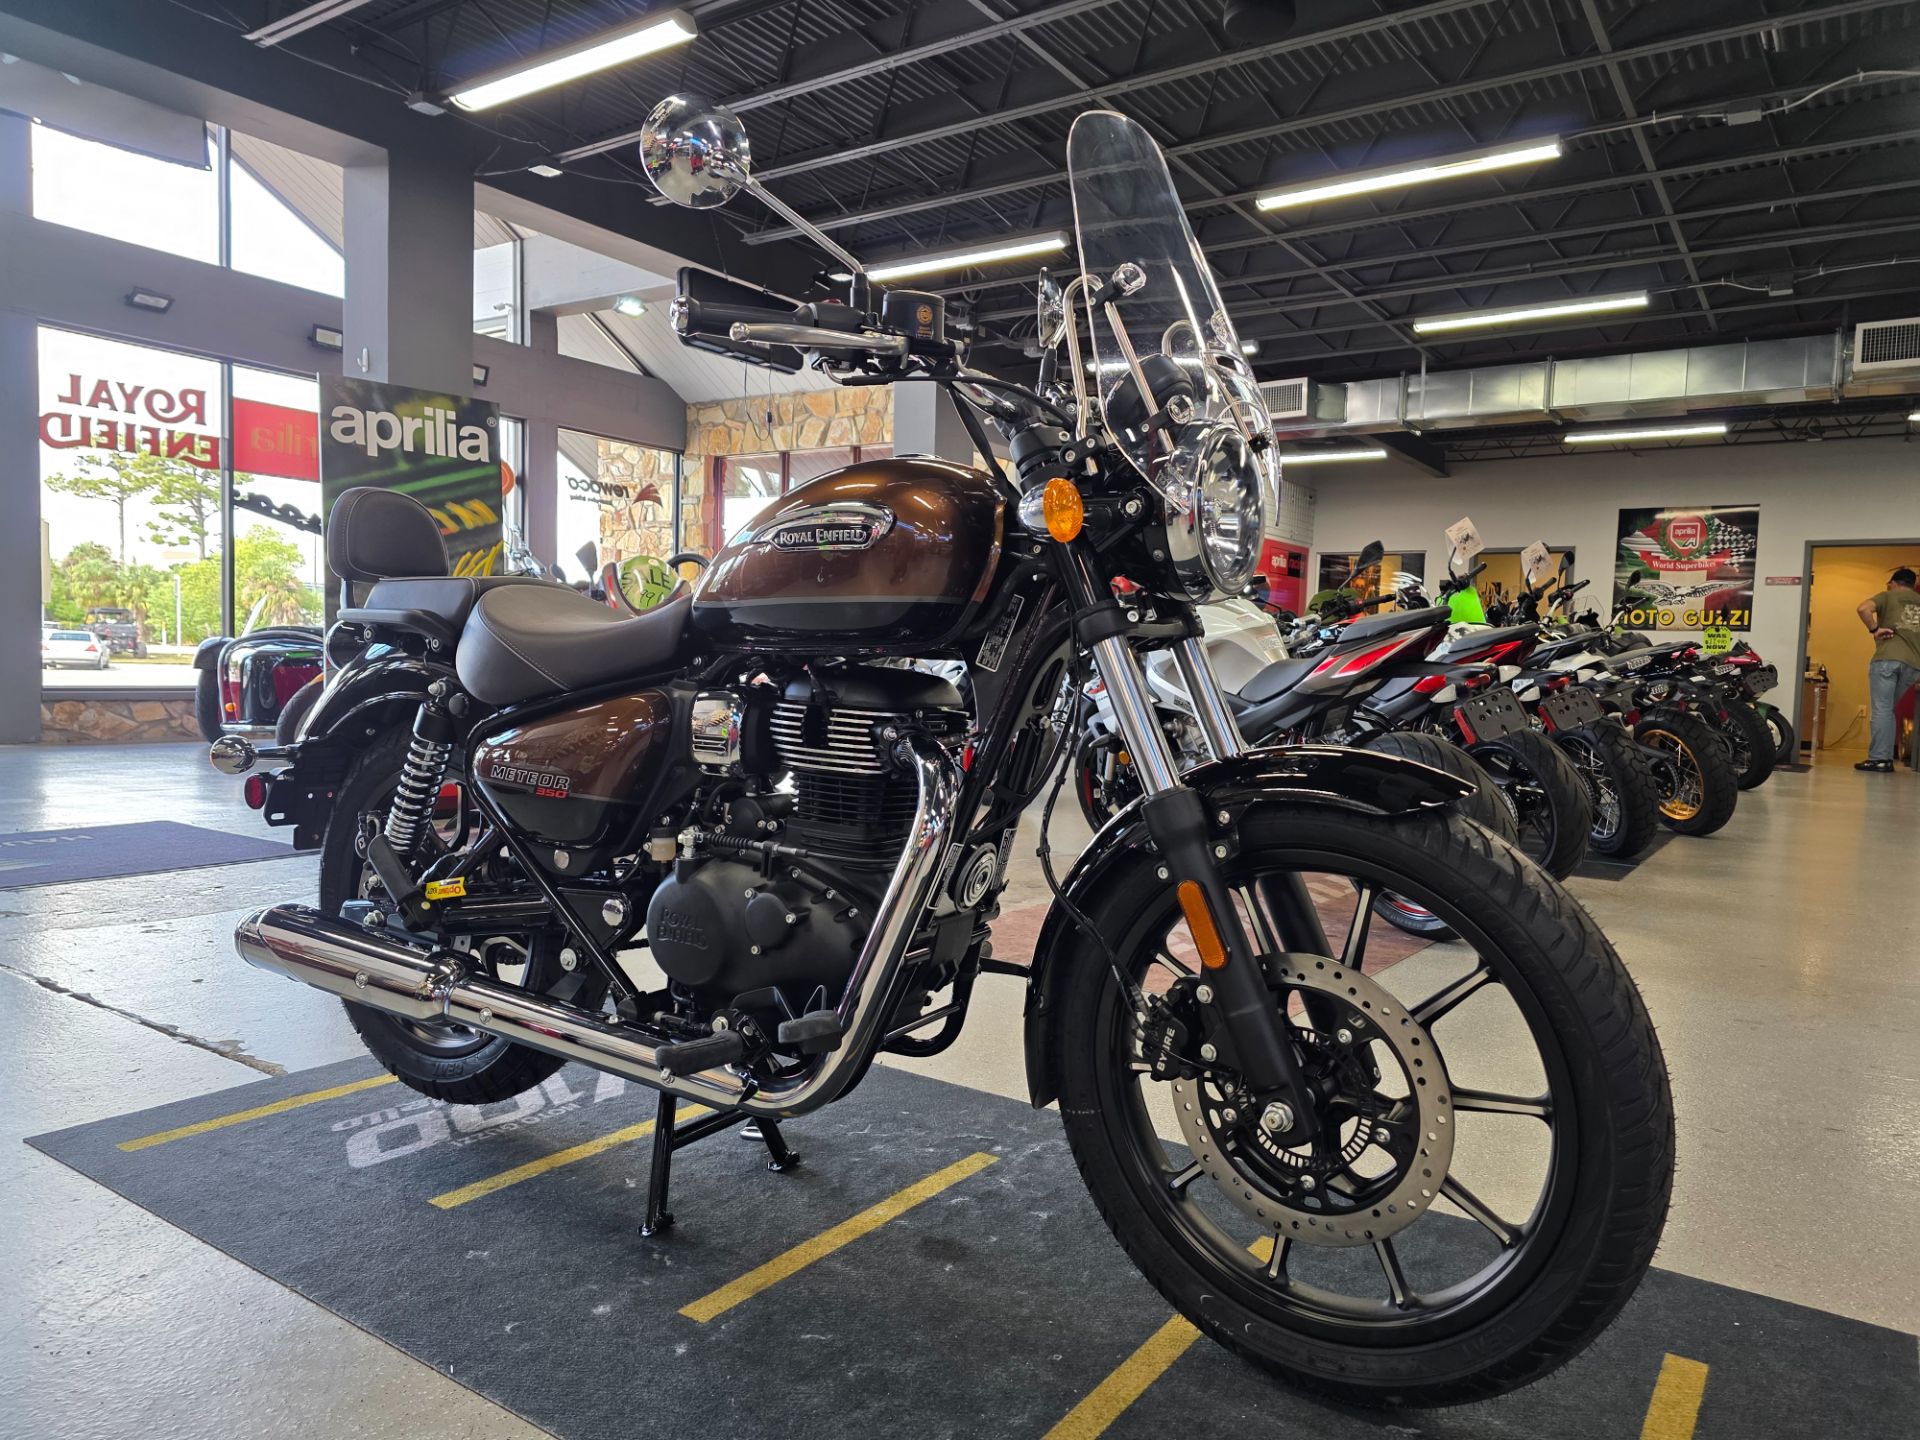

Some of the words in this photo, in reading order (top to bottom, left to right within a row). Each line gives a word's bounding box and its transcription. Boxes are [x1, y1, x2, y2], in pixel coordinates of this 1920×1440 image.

[330, 405, 490, 463] aprilia
[780, 531, 814, 545] ROYAL
[815, 528, 867, 543] ENFIELD
[1652, 560, 1674, 569] World
[490, 765, 570, 790] METEOR
[535, 786, 568, 798] 350
